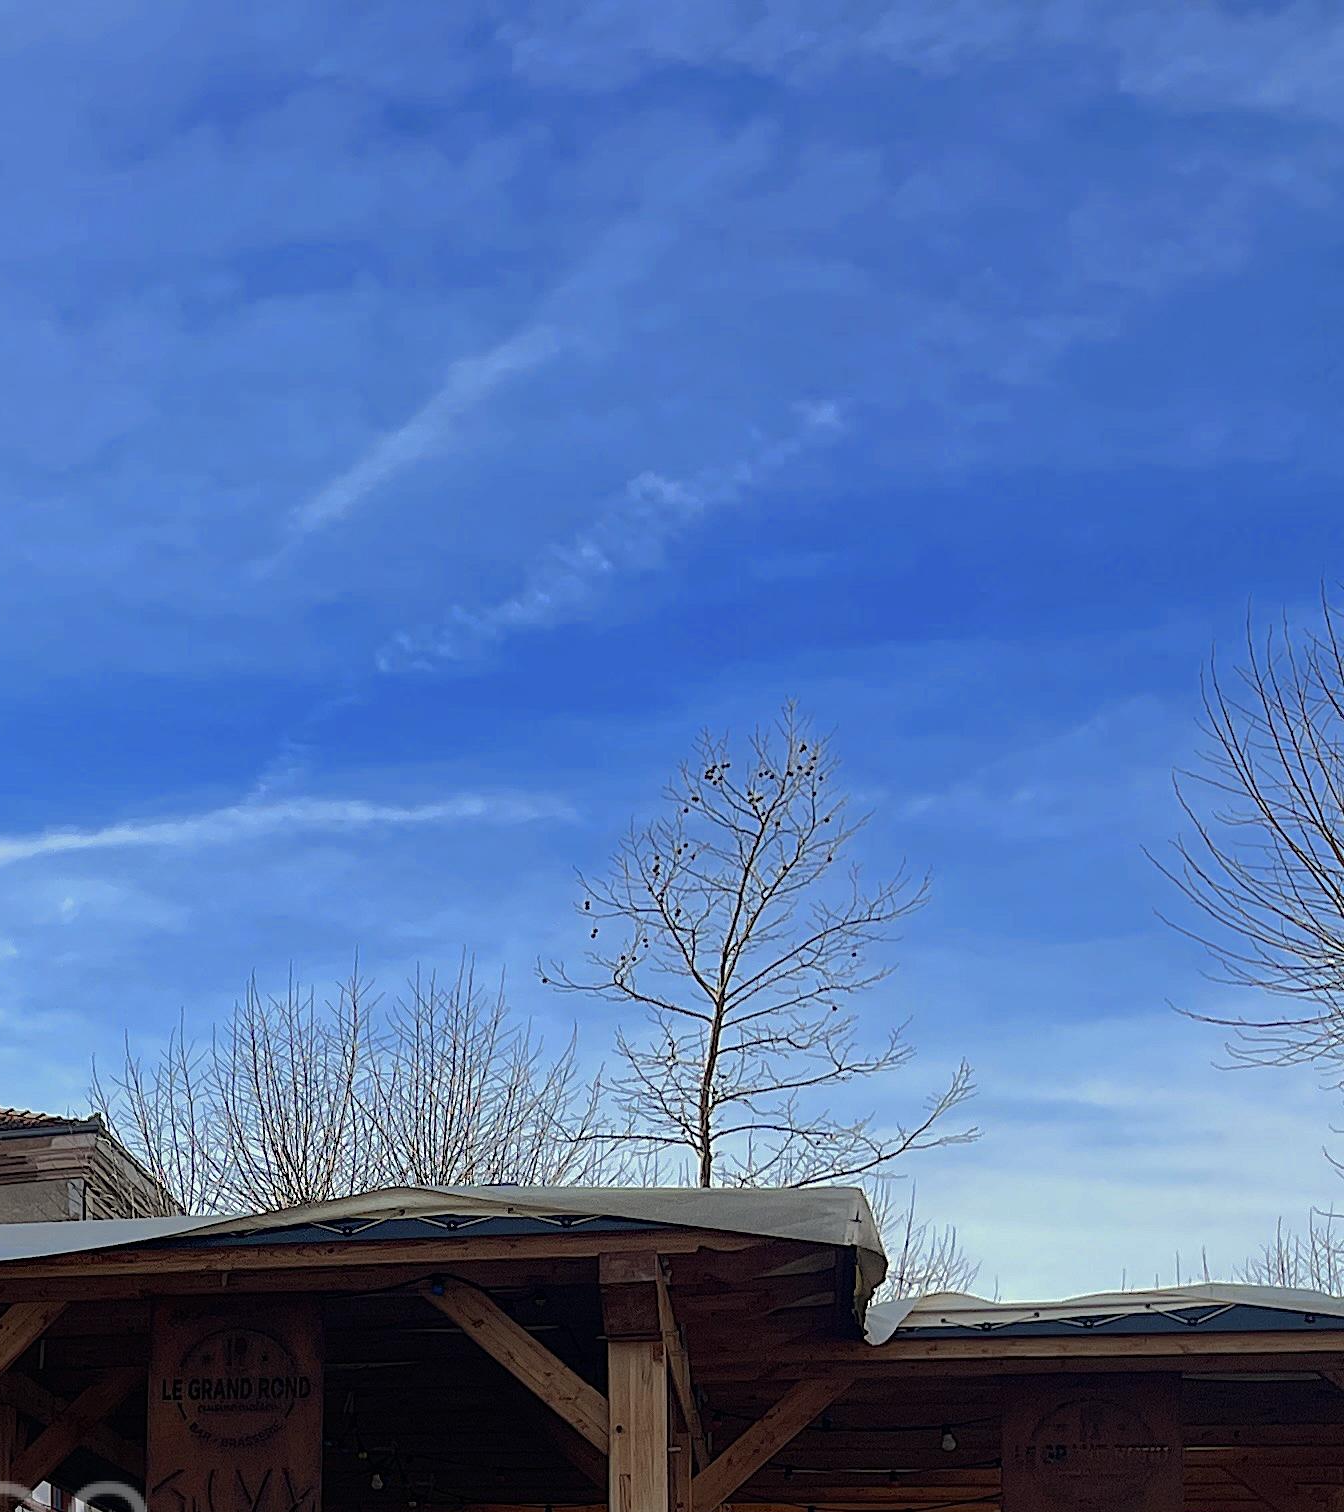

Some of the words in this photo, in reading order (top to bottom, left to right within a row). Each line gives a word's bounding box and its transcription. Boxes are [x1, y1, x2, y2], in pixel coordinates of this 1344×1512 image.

[162, 1378, 184, 1401] LE
[187, 1377, 253, 1401] GRAND
[257, 1376, 311, 1400] ROND
